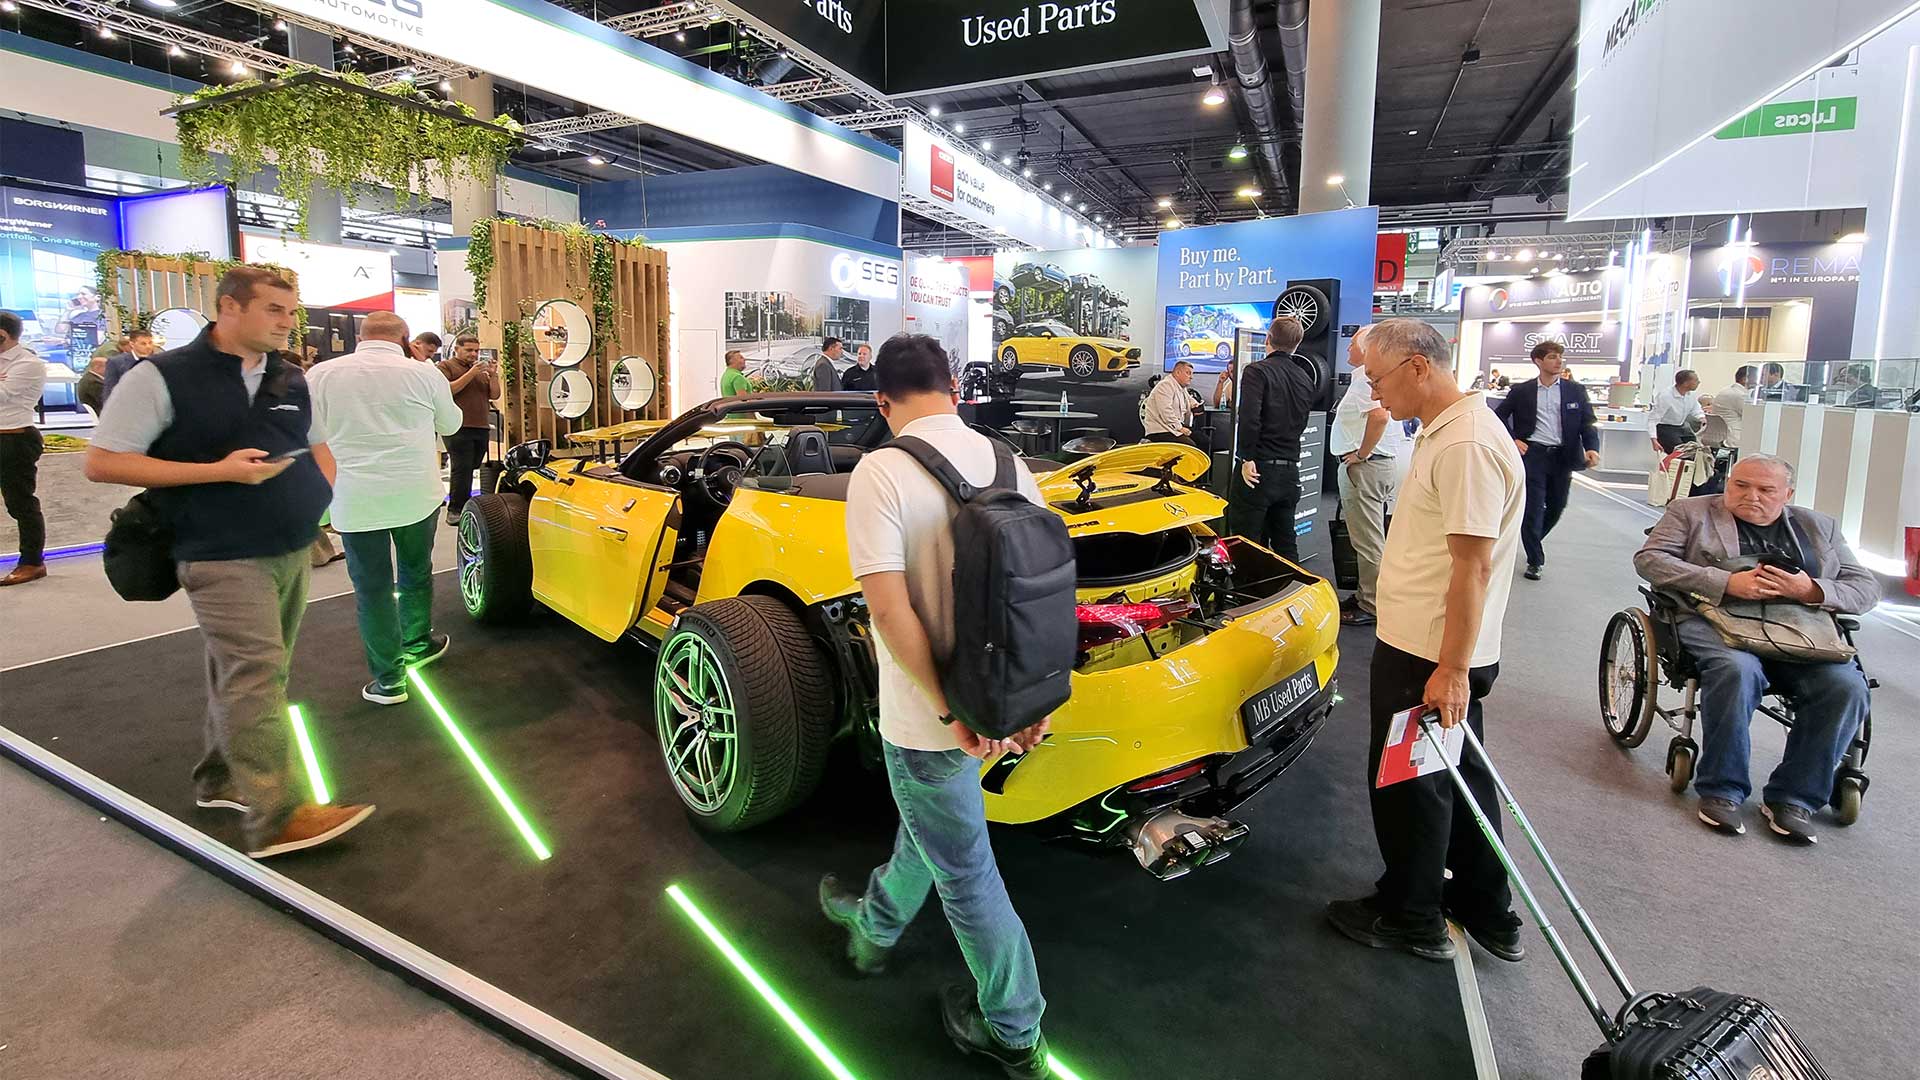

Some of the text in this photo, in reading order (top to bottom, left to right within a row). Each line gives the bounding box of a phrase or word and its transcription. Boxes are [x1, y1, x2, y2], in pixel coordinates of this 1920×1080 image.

[802, 0, 853, 34] arts
[961, 0, 1116, 47] Used Parts
[12, 197, 108, 216] BORGWARNER
[0, 217, 53, 229] orgWarner
[0, 232, 101, 248] ortfolio. One Partner.
[1179, 246, 1241, 268] Buy me.
[861, 260, 898, 286] SEG
[1179, 265, 1277, 291] Part by Part.
[1377, 259, 1399, 284] D
[1803, 275, 1846, 283] EUROPA
[910, 290, 951, 308] YOU CAN TRUST
[1523, 332, 1603, 349] START
[1252, 672, 1313, 726] MB Used Parts
